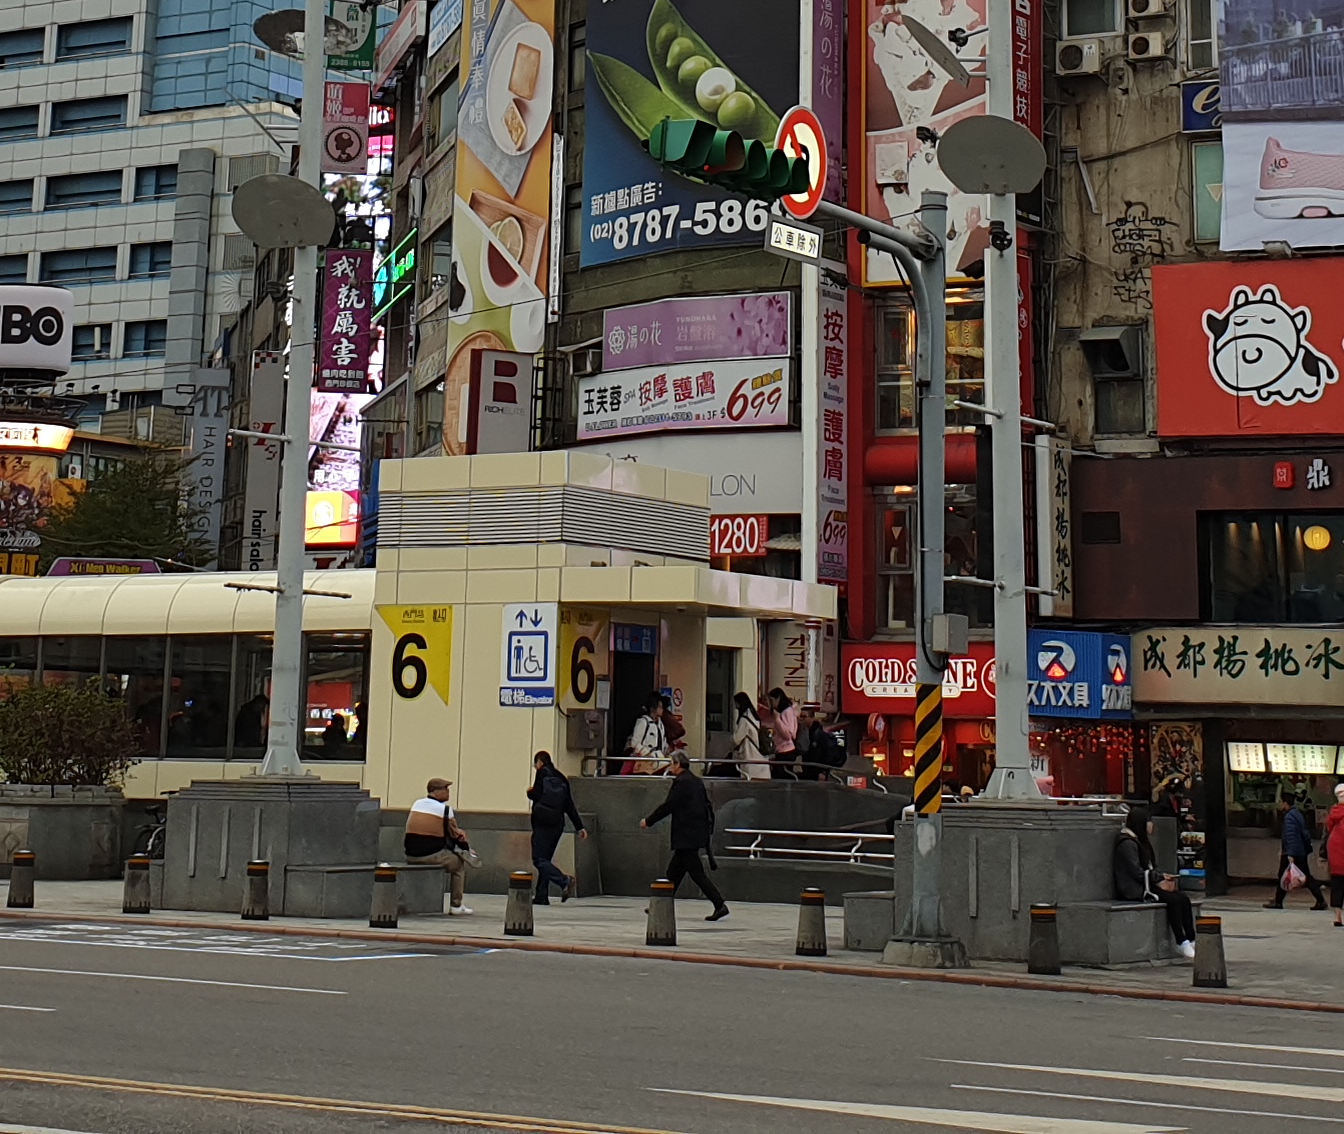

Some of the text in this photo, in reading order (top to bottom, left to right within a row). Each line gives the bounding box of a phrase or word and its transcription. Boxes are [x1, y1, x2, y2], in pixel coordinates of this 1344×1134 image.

[590, 199, 782, 250] (02)8787-586
[773, 228, 818, 259] 公車除外
[626, 321, 662, 349] 湯の花
[823, 308, 844, 379] 按摩
[583, 385, 622, 415] 玉芙蓉
[639, 373, 668, 407] 按摩
[672, 370, 716, 403] 護膚
[205, 425, 217, 477] HAIR
[823, 408, 844, 482] 護膚
[250, 509, 266, 572] hair salo
[711, 516, 758, 556] 1280
[392, 632, 596, 703] 6 6
[849, 658, 978, 692] COLD SNE
[500, 688, 525, 705] 電梯
